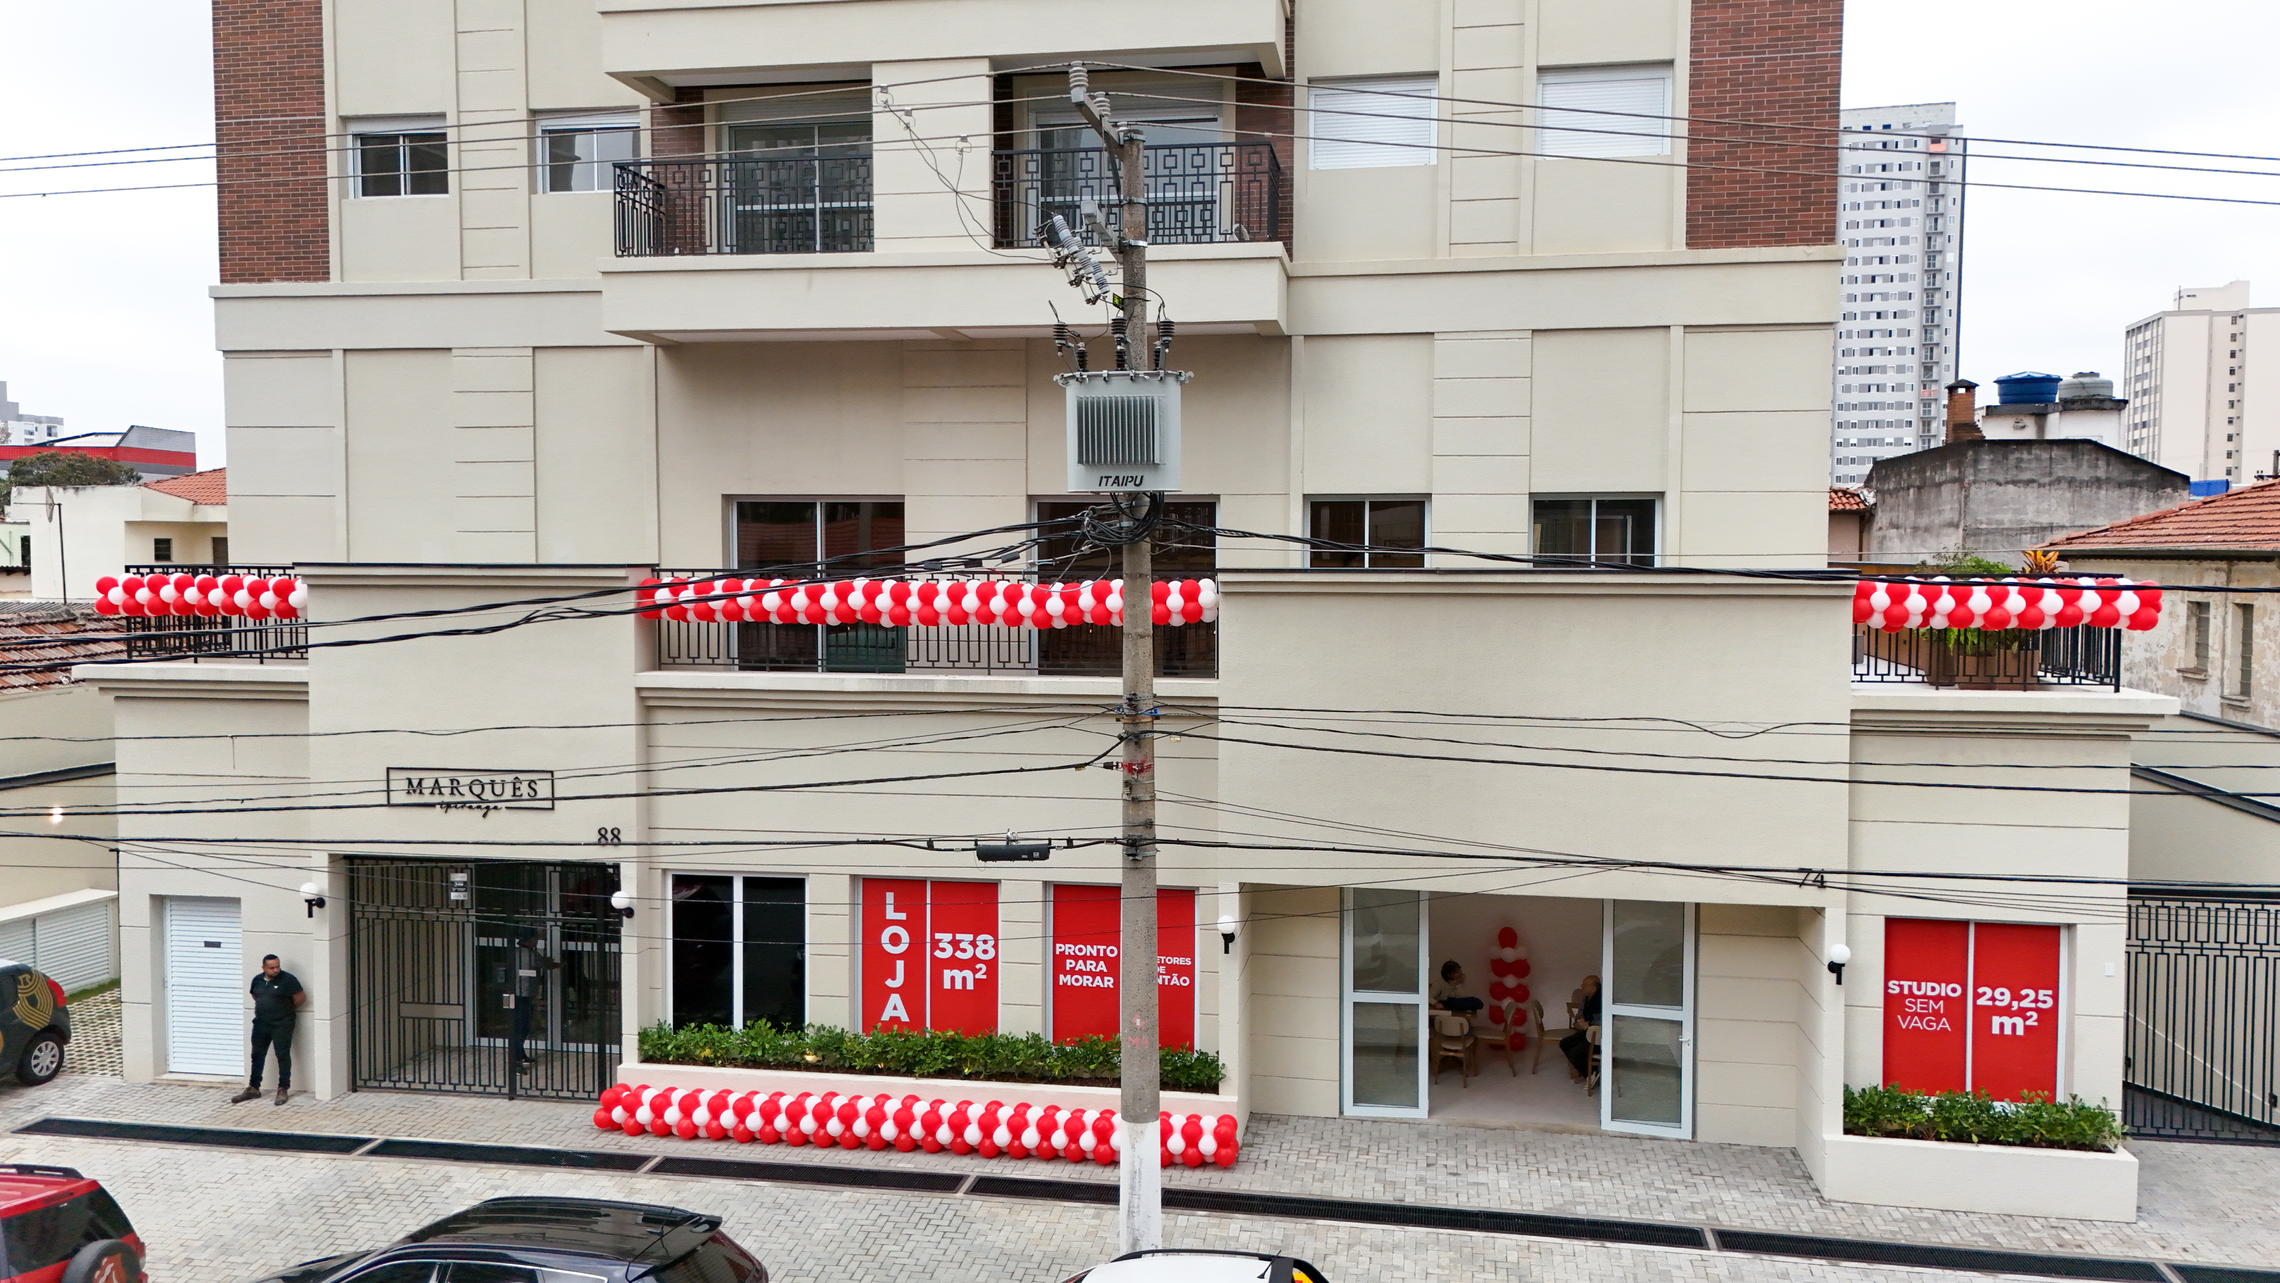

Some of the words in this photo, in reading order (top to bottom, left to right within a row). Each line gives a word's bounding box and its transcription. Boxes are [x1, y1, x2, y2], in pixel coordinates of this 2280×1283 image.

[1098, 475, 1144, 487] ITAIPU
[406, 776, 538, 800] MARQUÊS
[597, 826, 621, 846] 88
[1798, 867, 1827, 888] 74
[933, 932, 996, 960] 338
[1055, 943, 1118, 957] PRONTO
[880, 891, 910, 1022] LOJA
[1065, 959, 1107, 972] PARA
[1157, 965, 1166, 974] E
[1059, 974, 1114, 988] MORAR
[1887, 980, 1962, 997] STUDIO
[1905, 998, 1944, 1013] SEM
[1976, 986, 2053, 1011] 29,25
[1897, 1015, 1951, 1031] VAGA
